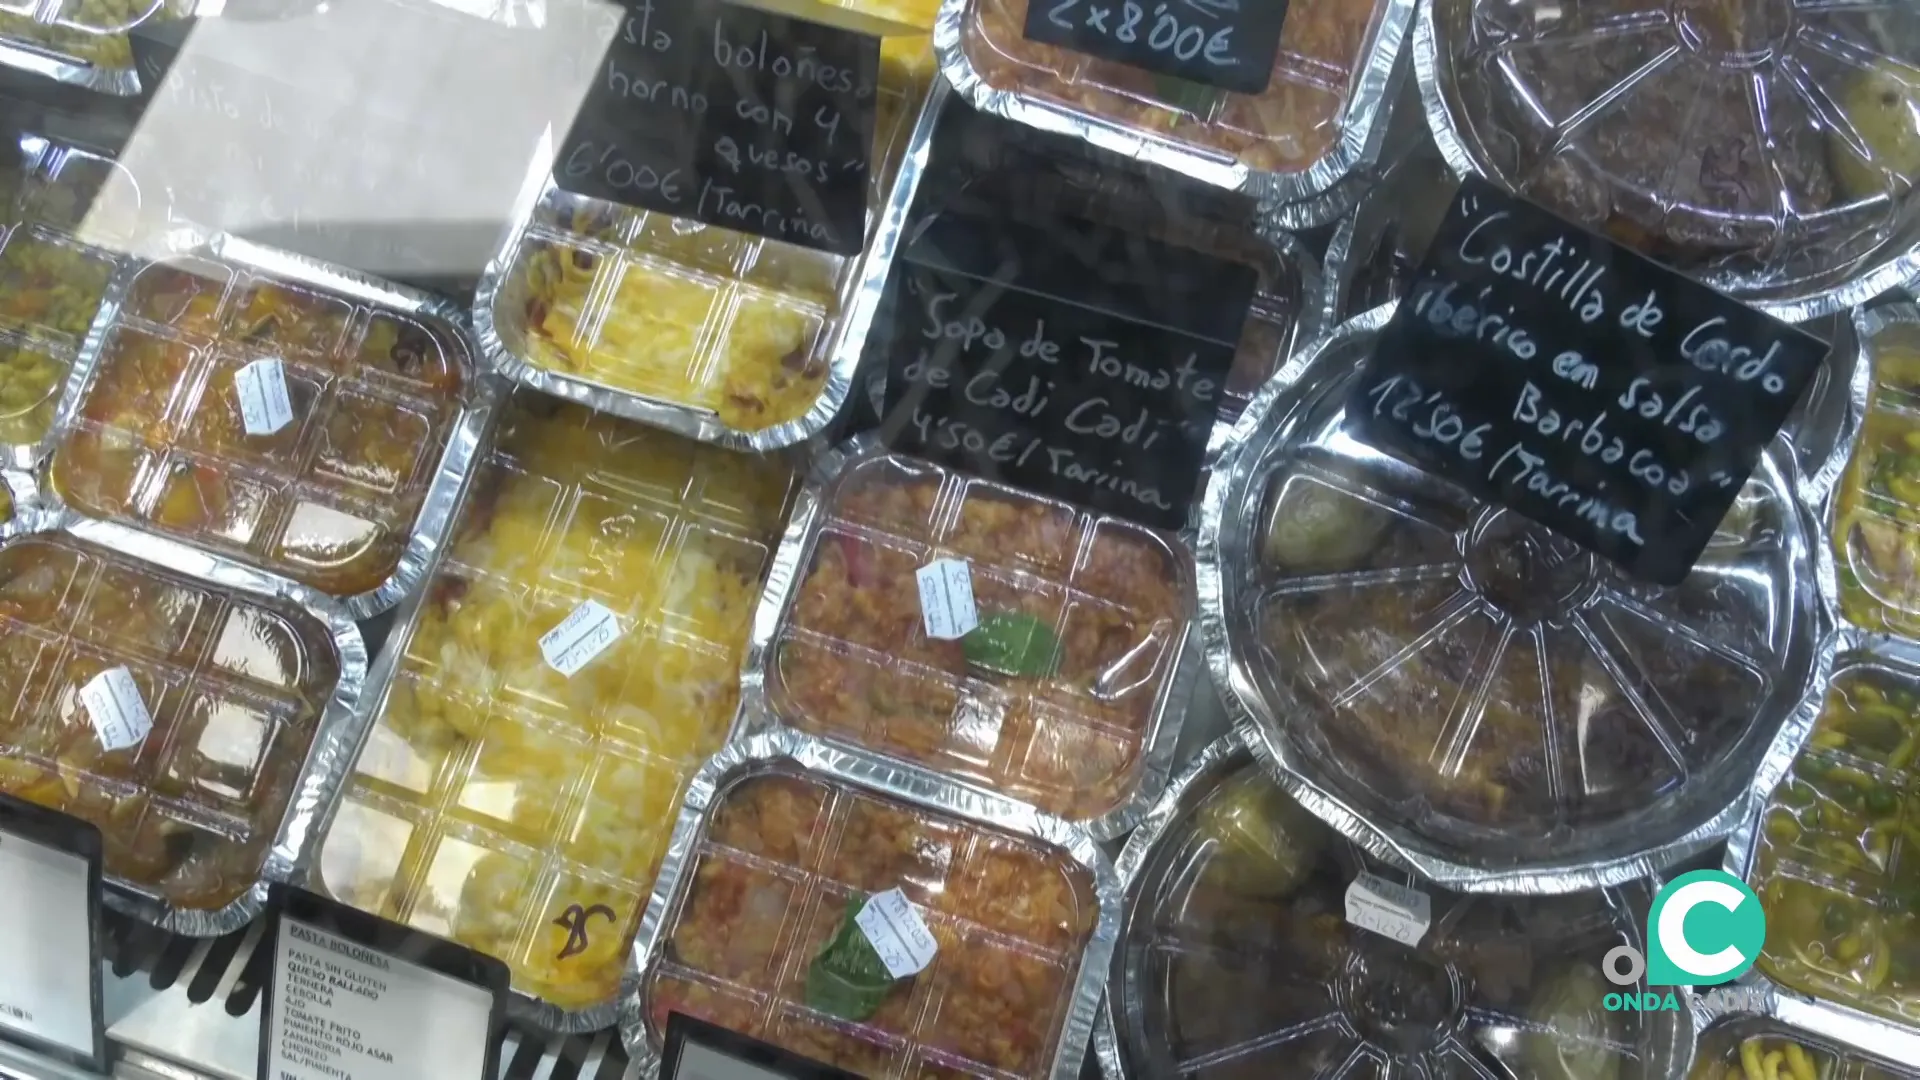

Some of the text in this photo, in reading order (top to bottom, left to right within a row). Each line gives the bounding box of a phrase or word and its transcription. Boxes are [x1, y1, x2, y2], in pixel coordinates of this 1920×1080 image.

[608, 60, 841, 147] horno con 4
[1619, 290, 1664, 338] de
[1020, 319, 1060, 363] de
[1080, 336, 1217, 401] Tomate
[1552, 350, 1600, 390] en
[903, 350, 950, 387] de
[964, 371, 1056, 417] Cadi
[290, 923, 327, 949] PASTA
[287, 960, 326, 981] QUESO
[288, 947, 387, 992] PASTA SIN GLUTEN
[285, 983, 332, 1008] CEBOLLA
[285, 995, 306, 1009] AJO
[283, 1016, 333, 1041] PIMIENTO
[336, 1035, 364, 1054] ROJO
[284, 1005, 361, 1041] TOMATE FRITO
